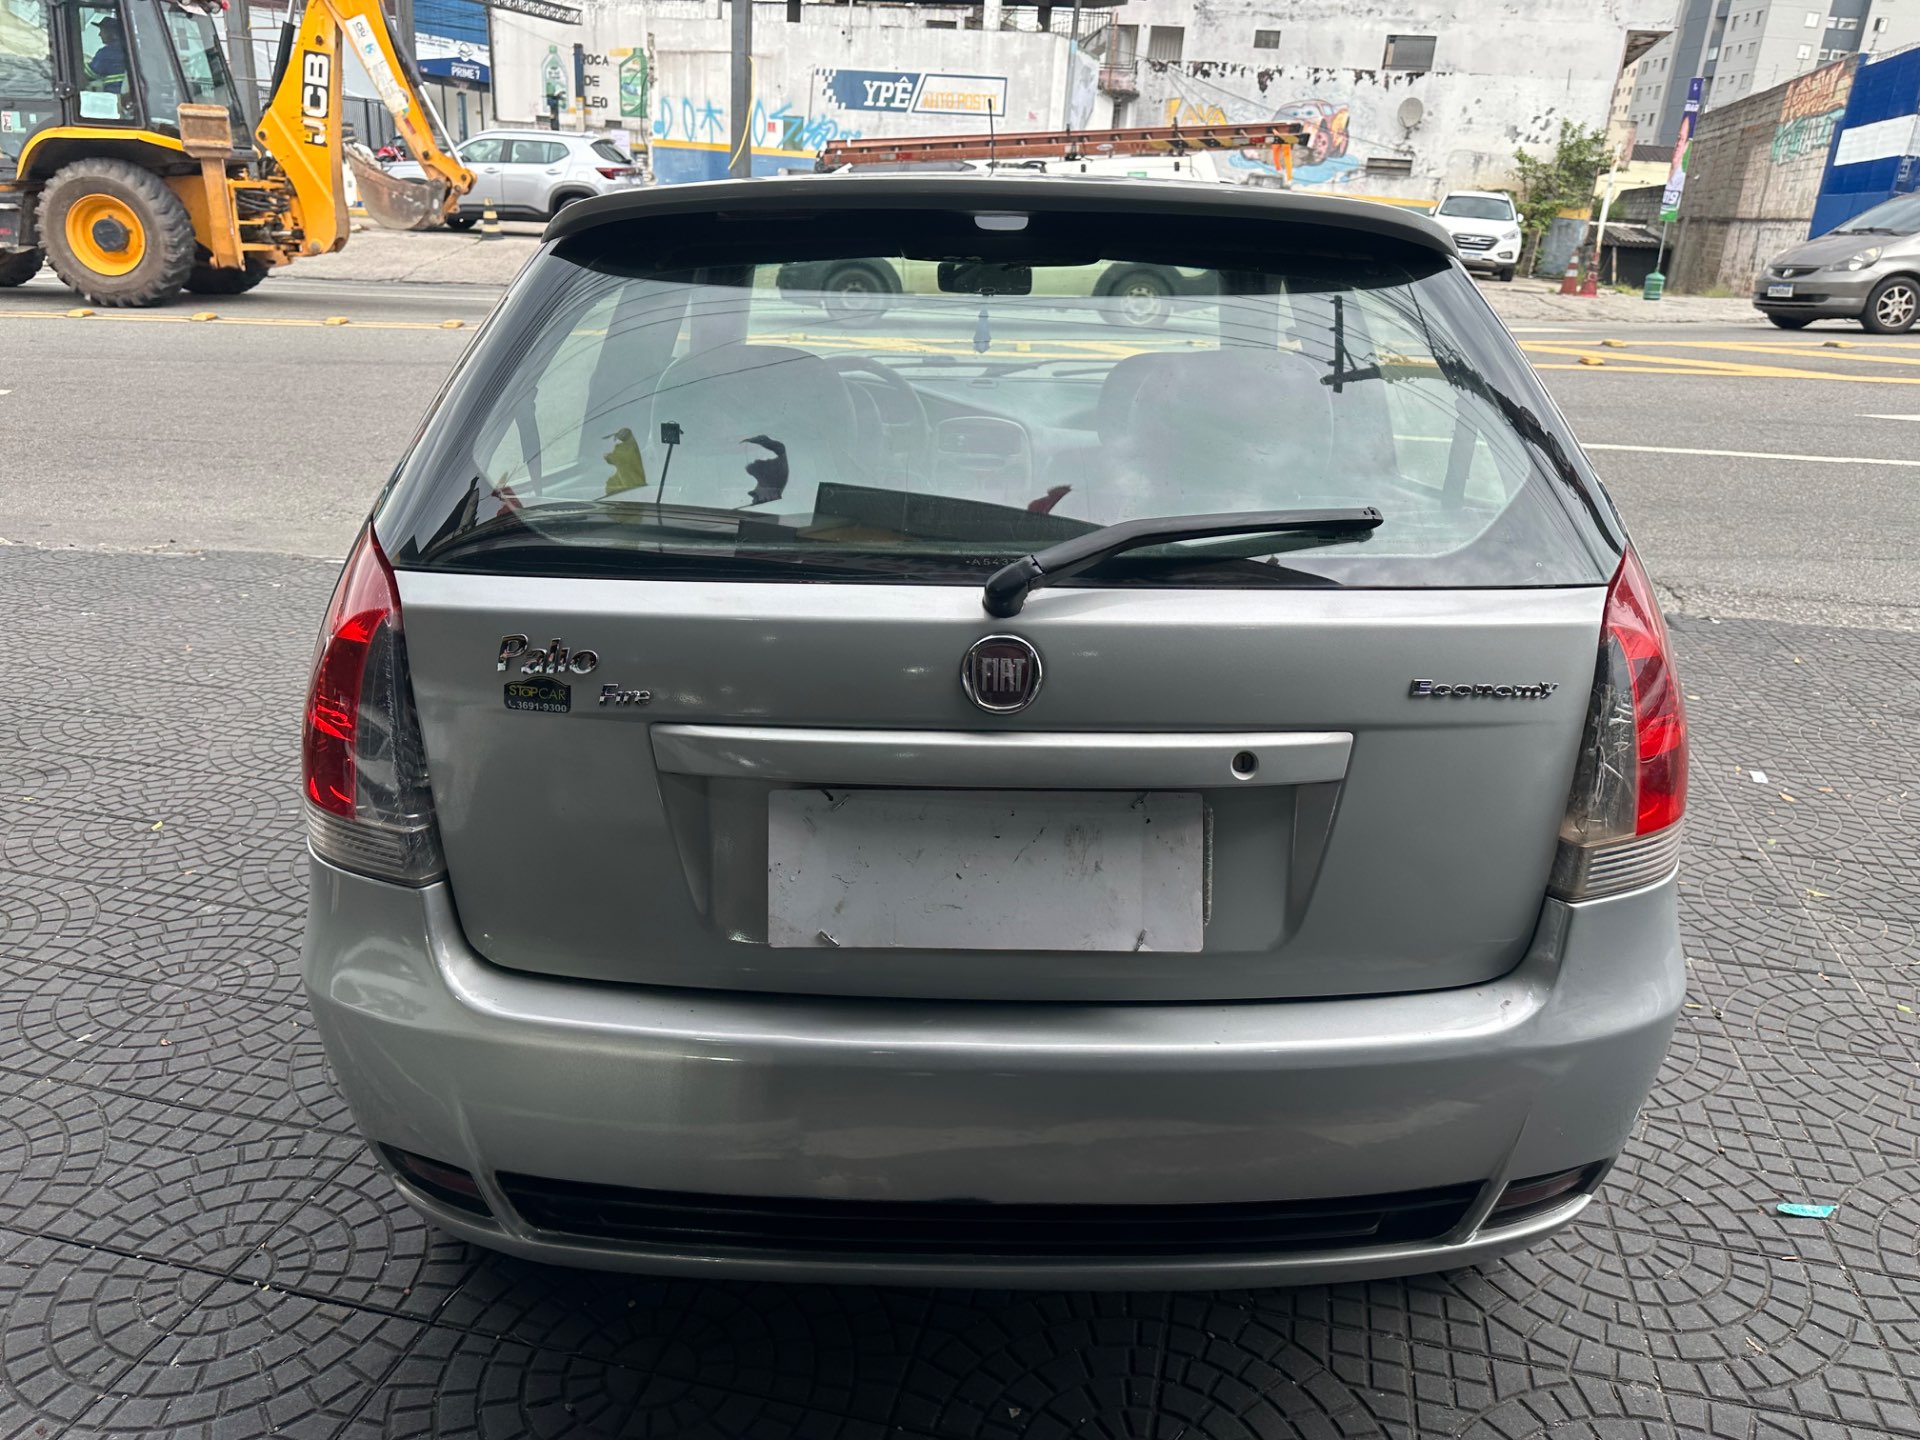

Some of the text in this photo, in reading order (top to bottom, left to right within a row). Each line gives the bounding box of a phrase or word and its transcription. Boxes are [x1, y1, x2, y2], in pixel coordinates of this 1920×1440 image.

[584, 76, 600, 87] DE
[303, 53, 330, 145] JCB
[585, 97, 608, 109] LEO
[863, 76, 997, 111] YPÊ AUTO POSTO
[496, 633, 600, 675] Palio
[981, 657, 1027, 692] FIAT
[599, 683, 652, 706] Fire
[1410, 678, 1560, 699] Economy
[516, 701, 567, 713] 3691-9300
